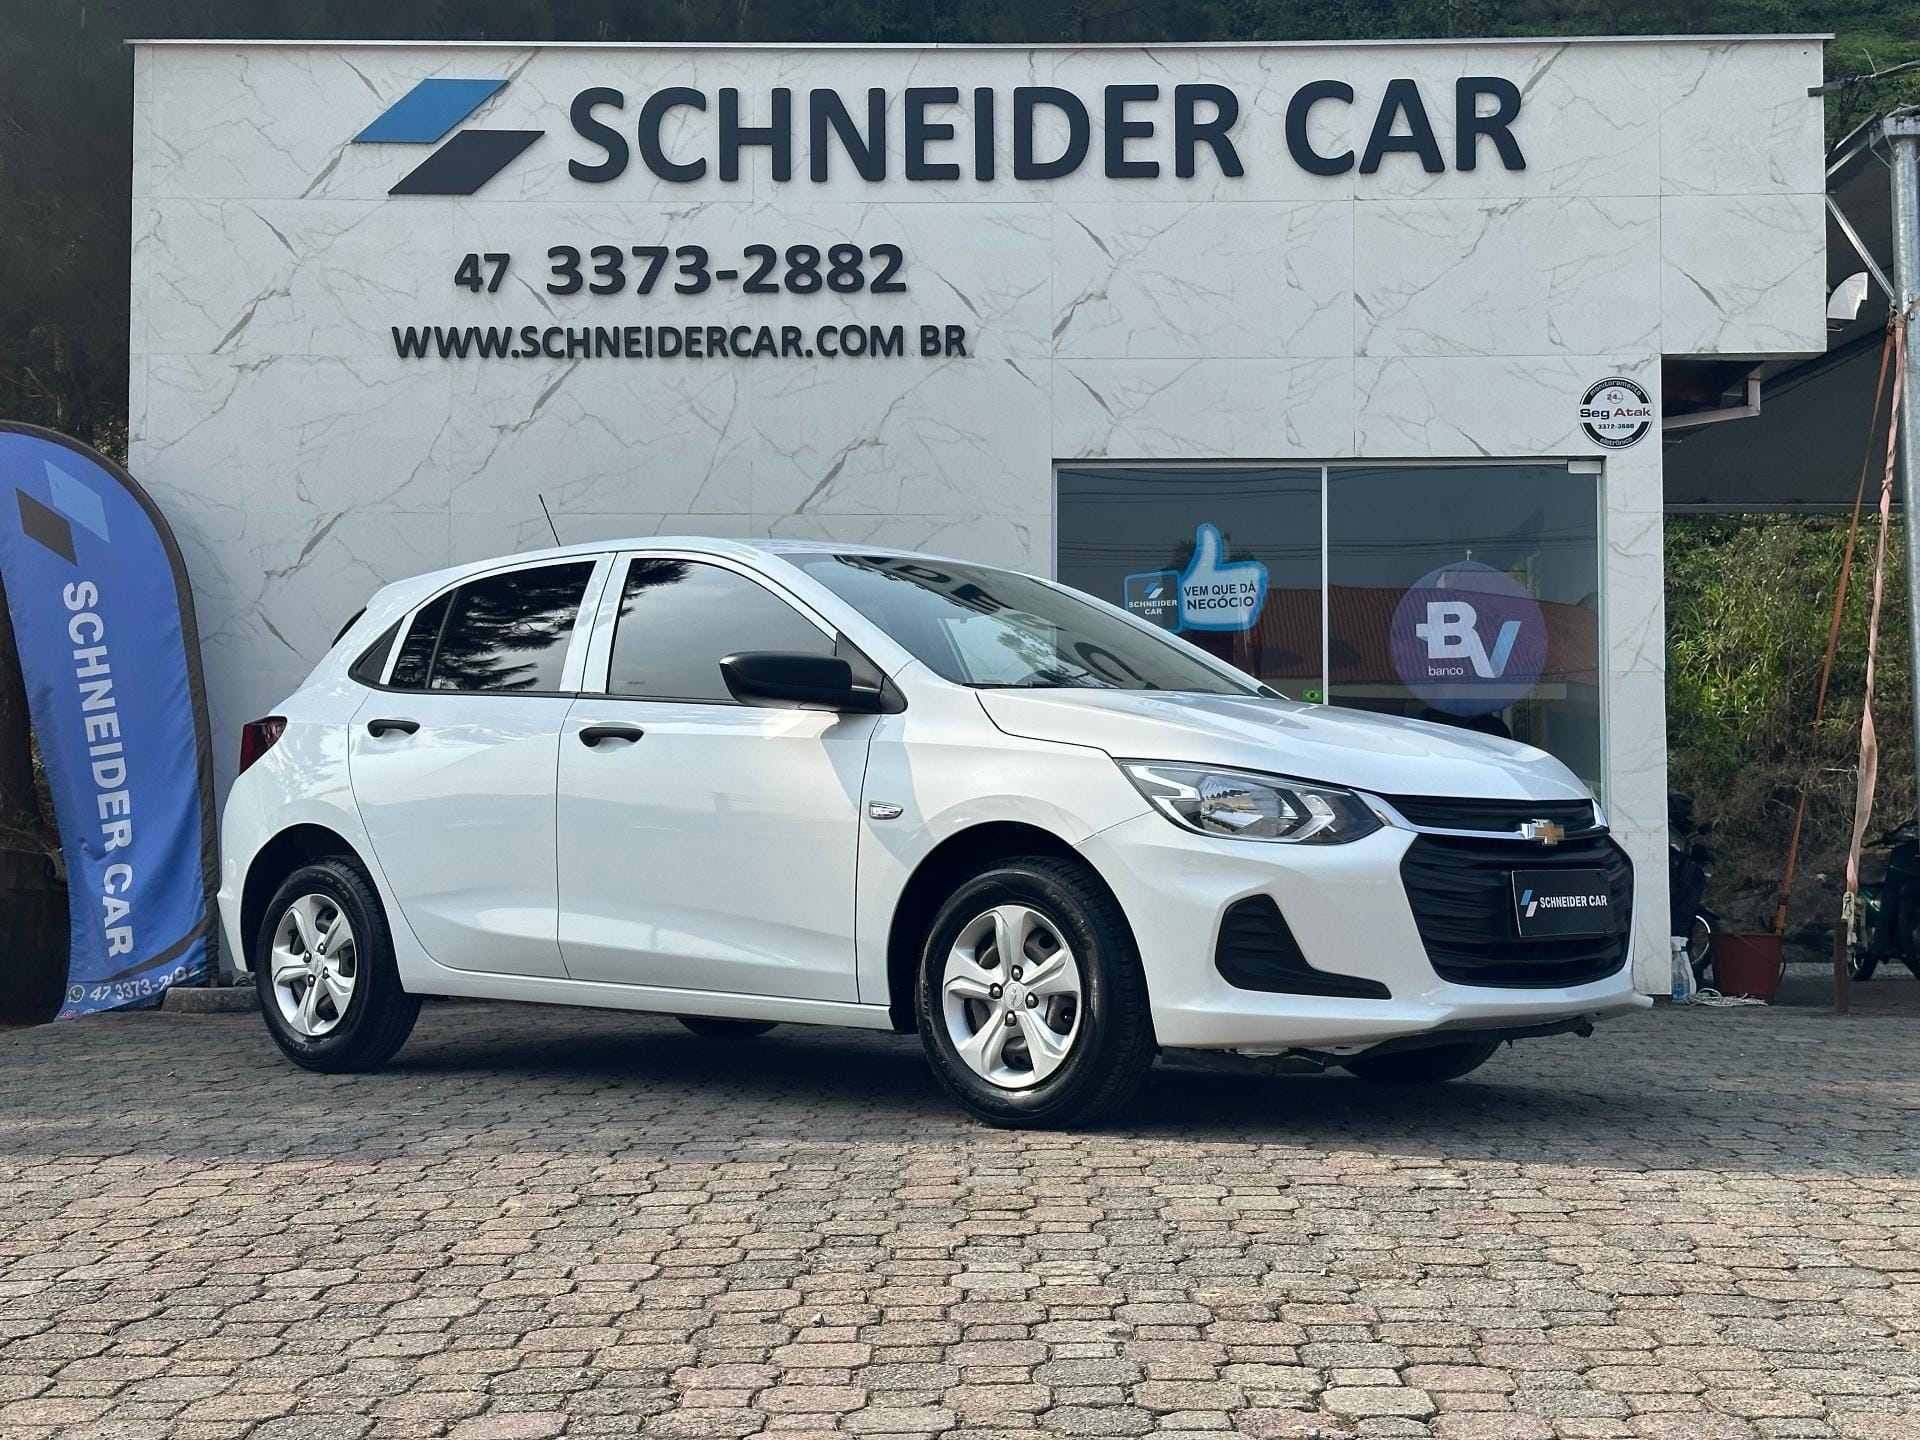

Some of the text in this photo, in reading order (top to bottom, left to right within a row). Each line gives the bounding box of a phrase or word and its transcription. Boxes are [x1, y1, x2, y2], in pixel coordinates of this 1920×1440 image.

[568, 77, 1527, 186] SCHNEIDER CAR
[454, 243, 908, 296] 47 3373-2882
[920, 324, 967, 358] BR
[1580, 407, 1652, 420] Seg Atak
[1184, 580, 1257, 597] VEM QUE DÁ
[1128, 599, 1178, 608] SCHNEIDER
[1187, 596, 1255, 610] NEGÓCIO
[1428, 665, 1464, 676] banco
[63, 580, 134, 958] SCHNEIDER CAR
[1540, 894, 1608, 908] SCHNEIDER CAR
[89, 986, 111, 1001] 47
